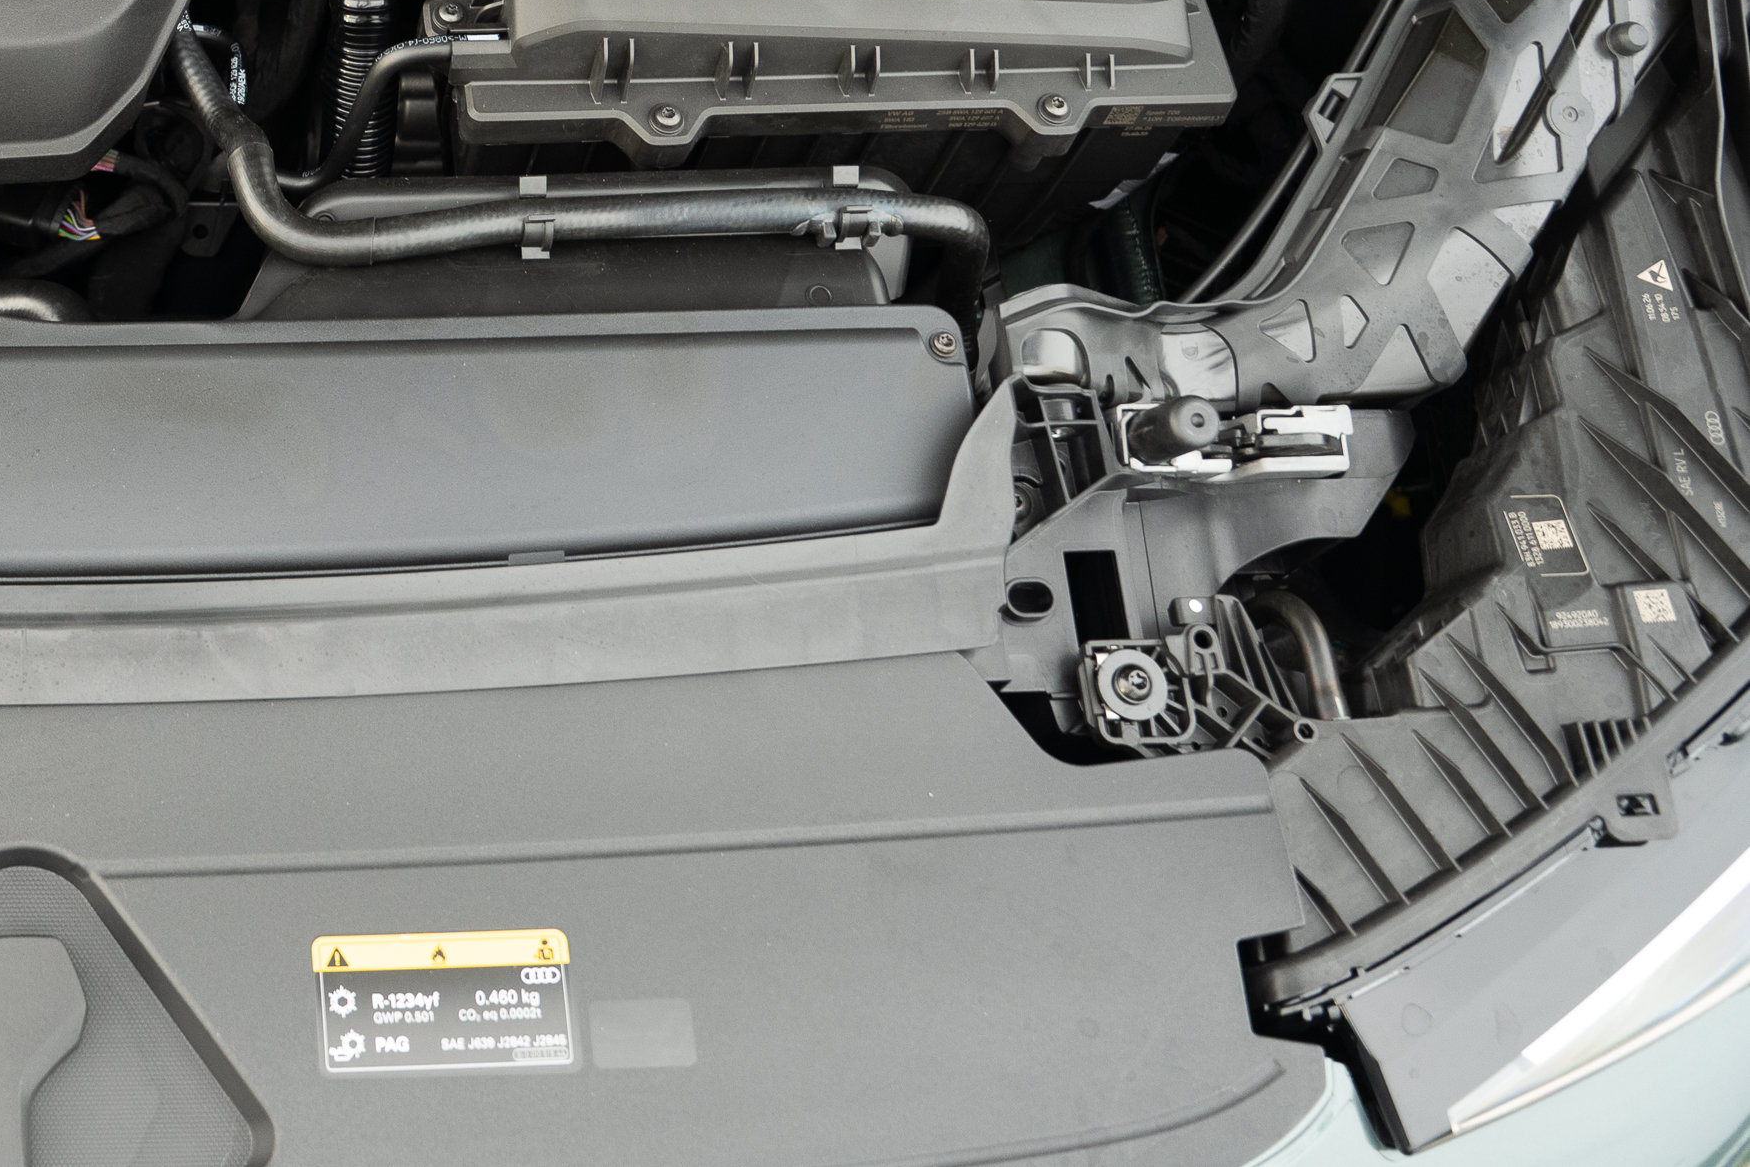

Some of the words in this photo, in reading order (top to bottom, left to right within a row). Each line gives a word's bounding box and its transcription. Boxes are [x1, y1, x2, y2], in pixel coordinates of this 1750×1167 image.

[520, 988, 541, 1006] kg
[373, 1012, 403, 1025] GWP
[375, 1036, 410, 1053] PAG
[440, 1037, 465, 1051] SAE
